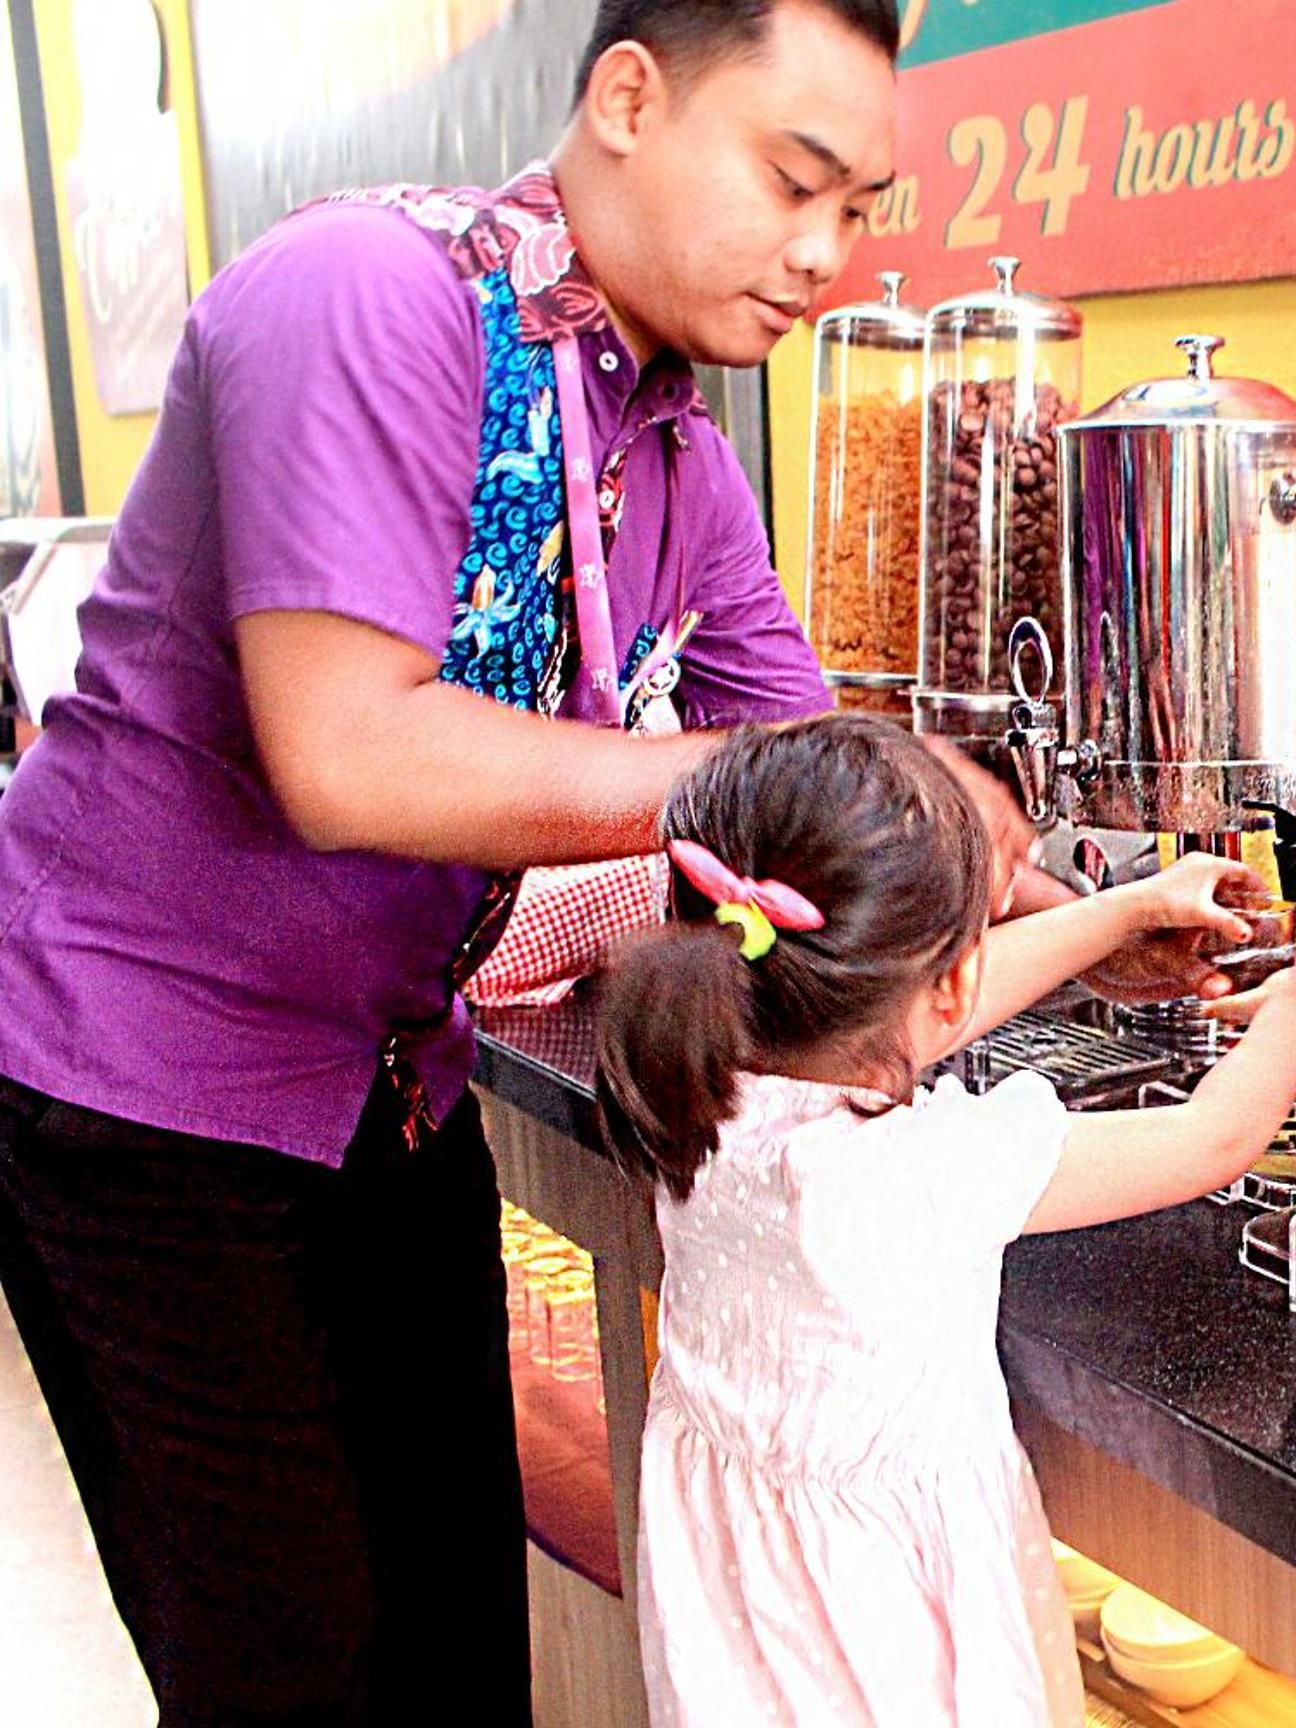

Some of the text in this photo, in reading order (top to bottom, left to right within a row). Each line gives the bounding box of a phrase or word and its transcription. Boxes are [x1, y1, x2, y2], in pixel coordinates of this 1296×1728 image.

[867, 95, 1296, 249] en 24 hours
